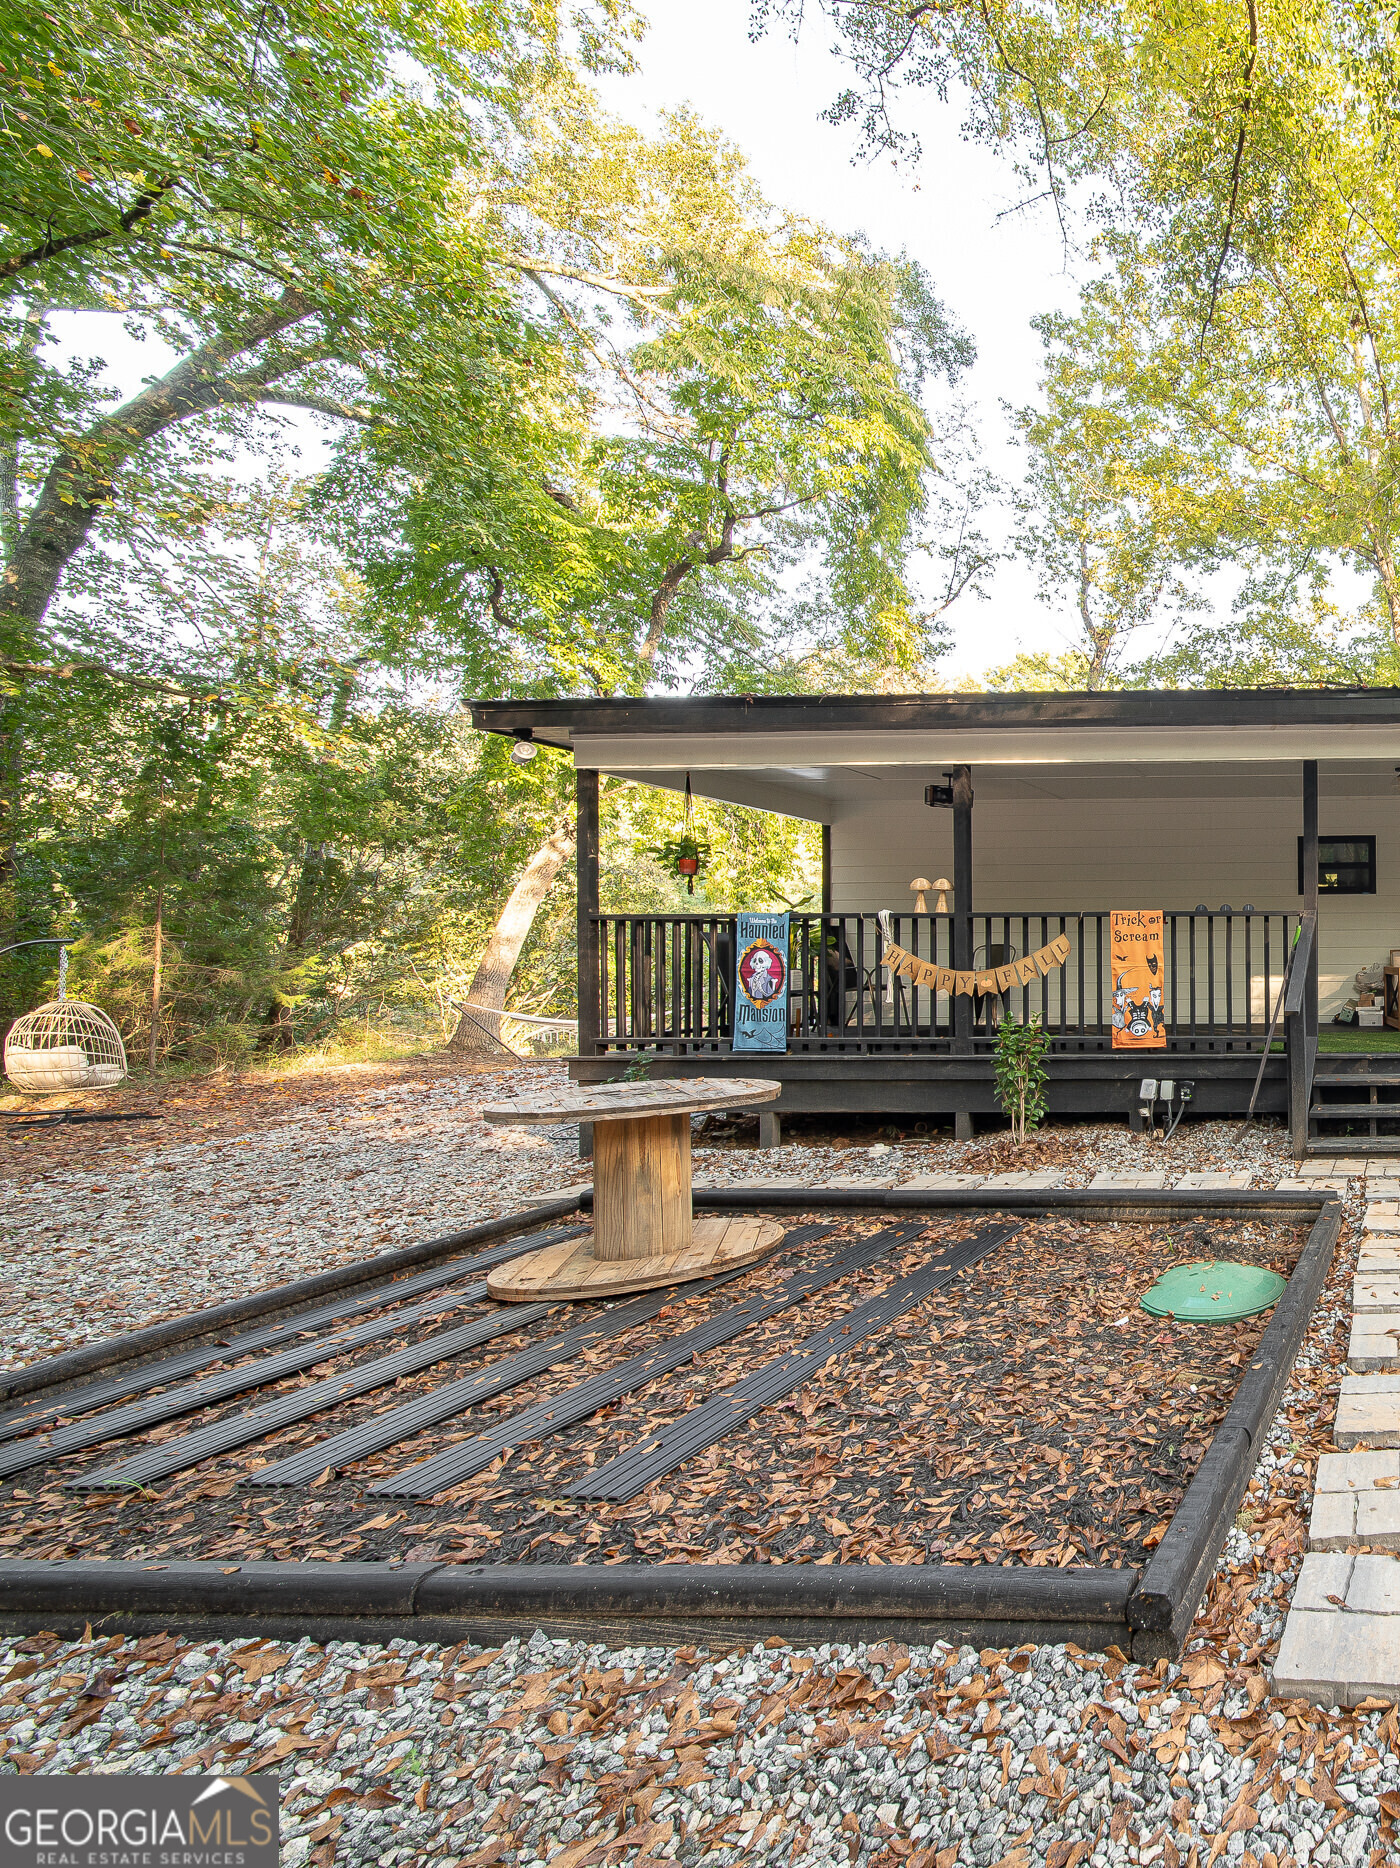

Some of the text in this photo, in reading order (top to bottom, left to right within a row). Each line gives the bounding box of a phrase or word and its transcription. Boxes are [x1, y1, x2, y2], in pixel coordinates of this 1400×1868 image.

[1112, 911, 1162, 928] Trick or
[740, 921, 785, 939] Haunted
[1114, 929, 1159, 943] Scream
[887, 944, 1069, 988] HAPPY FALL
[737, 1003, 786, 1025] Mansion
